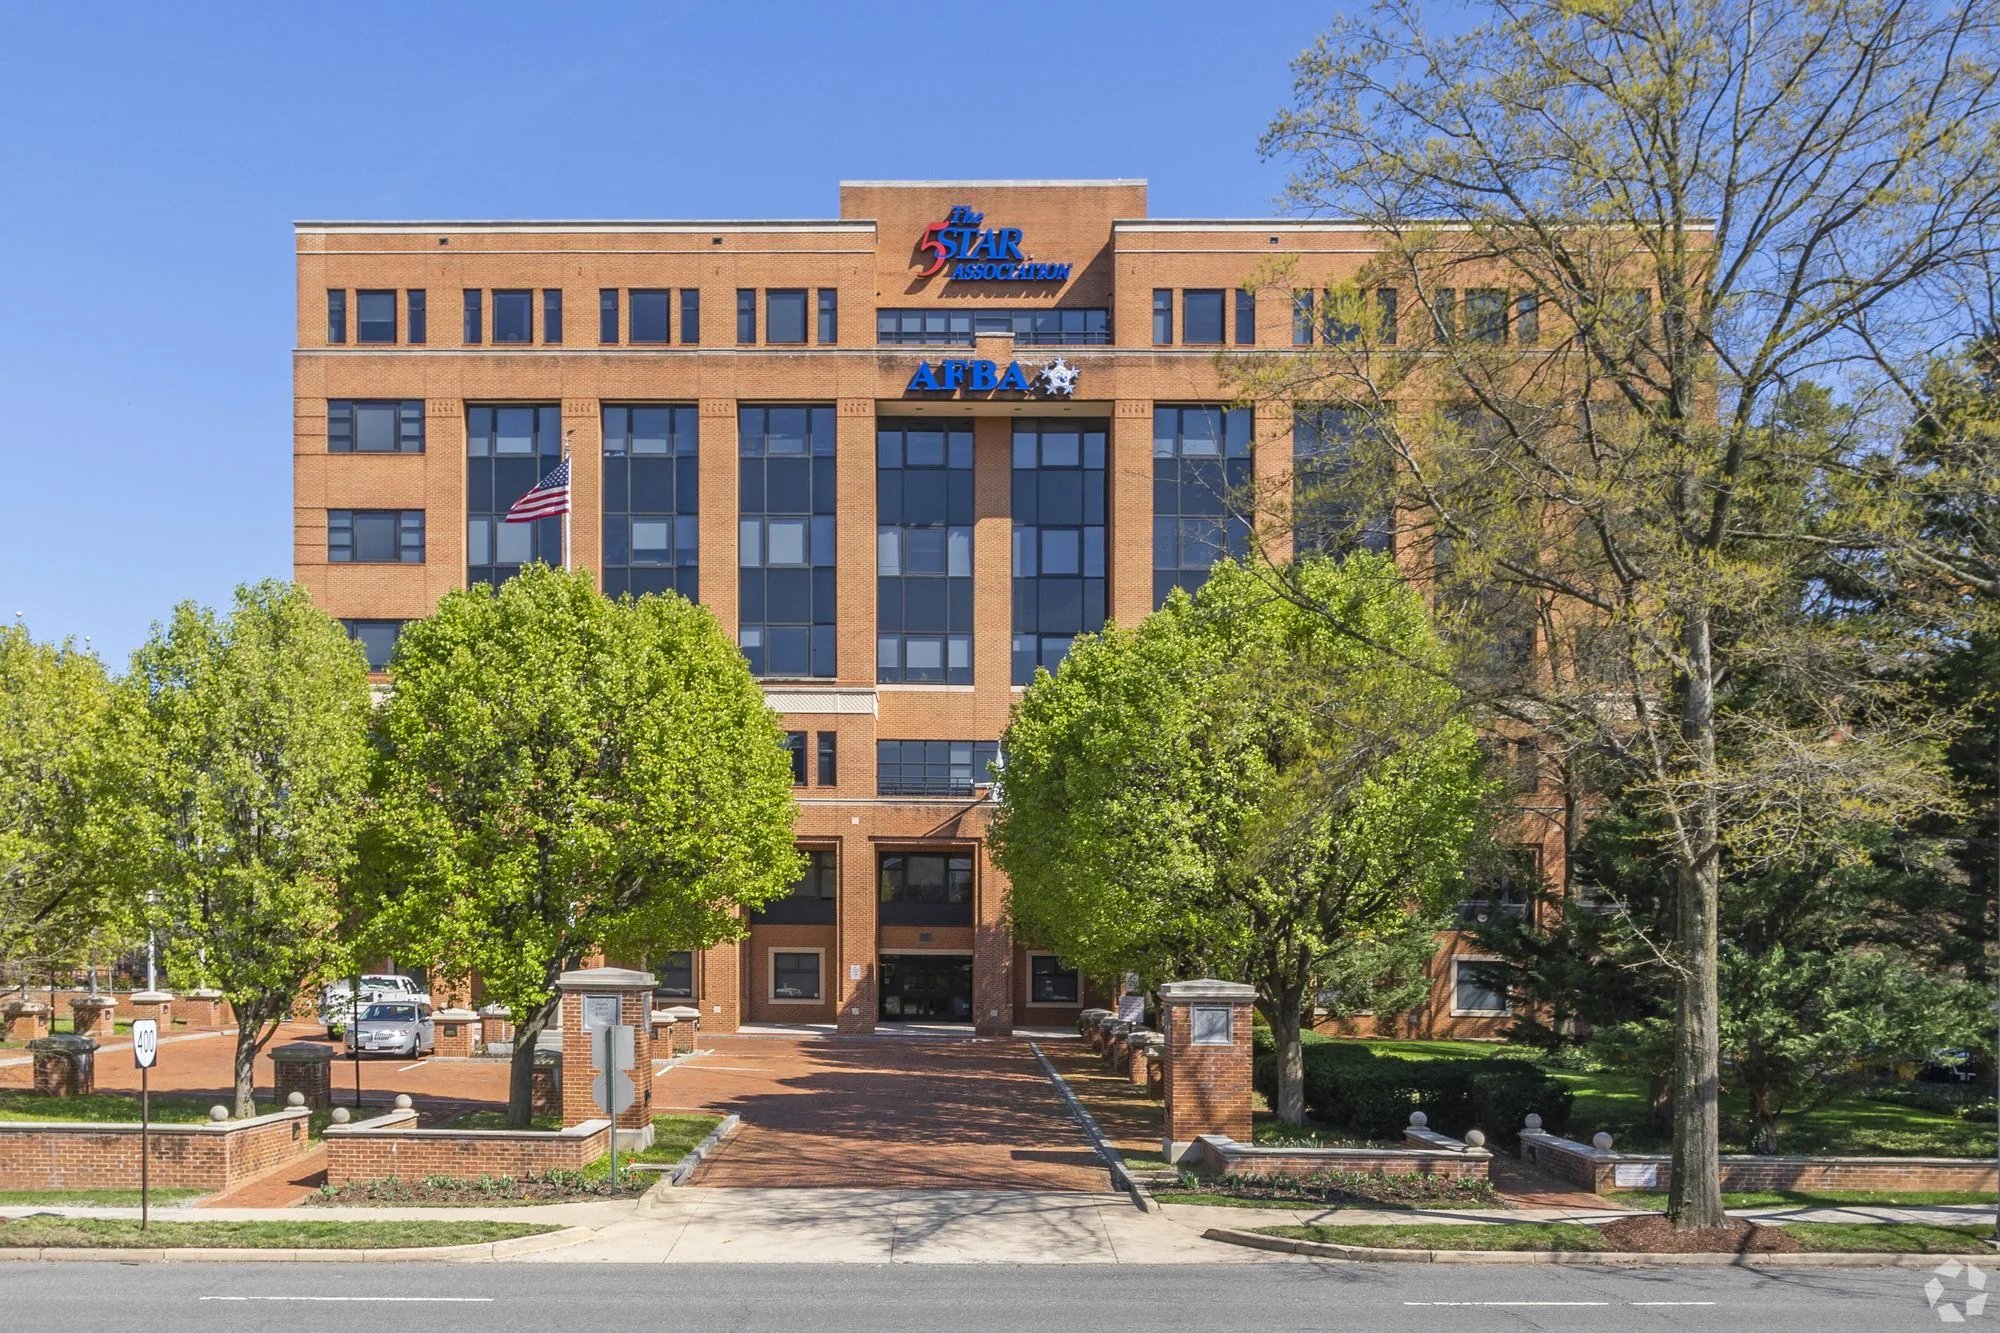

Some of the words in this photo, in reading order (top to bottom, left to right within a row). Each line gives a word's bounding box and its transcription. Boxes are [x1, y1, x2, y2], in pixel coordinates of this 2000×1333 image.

[951, 205, 985, 224] The
[950, 262, 1073, 281] ASSOCIATION
[907, 359, 1031, 391] AFBA
[137, 1029, 154, 1053] 400
